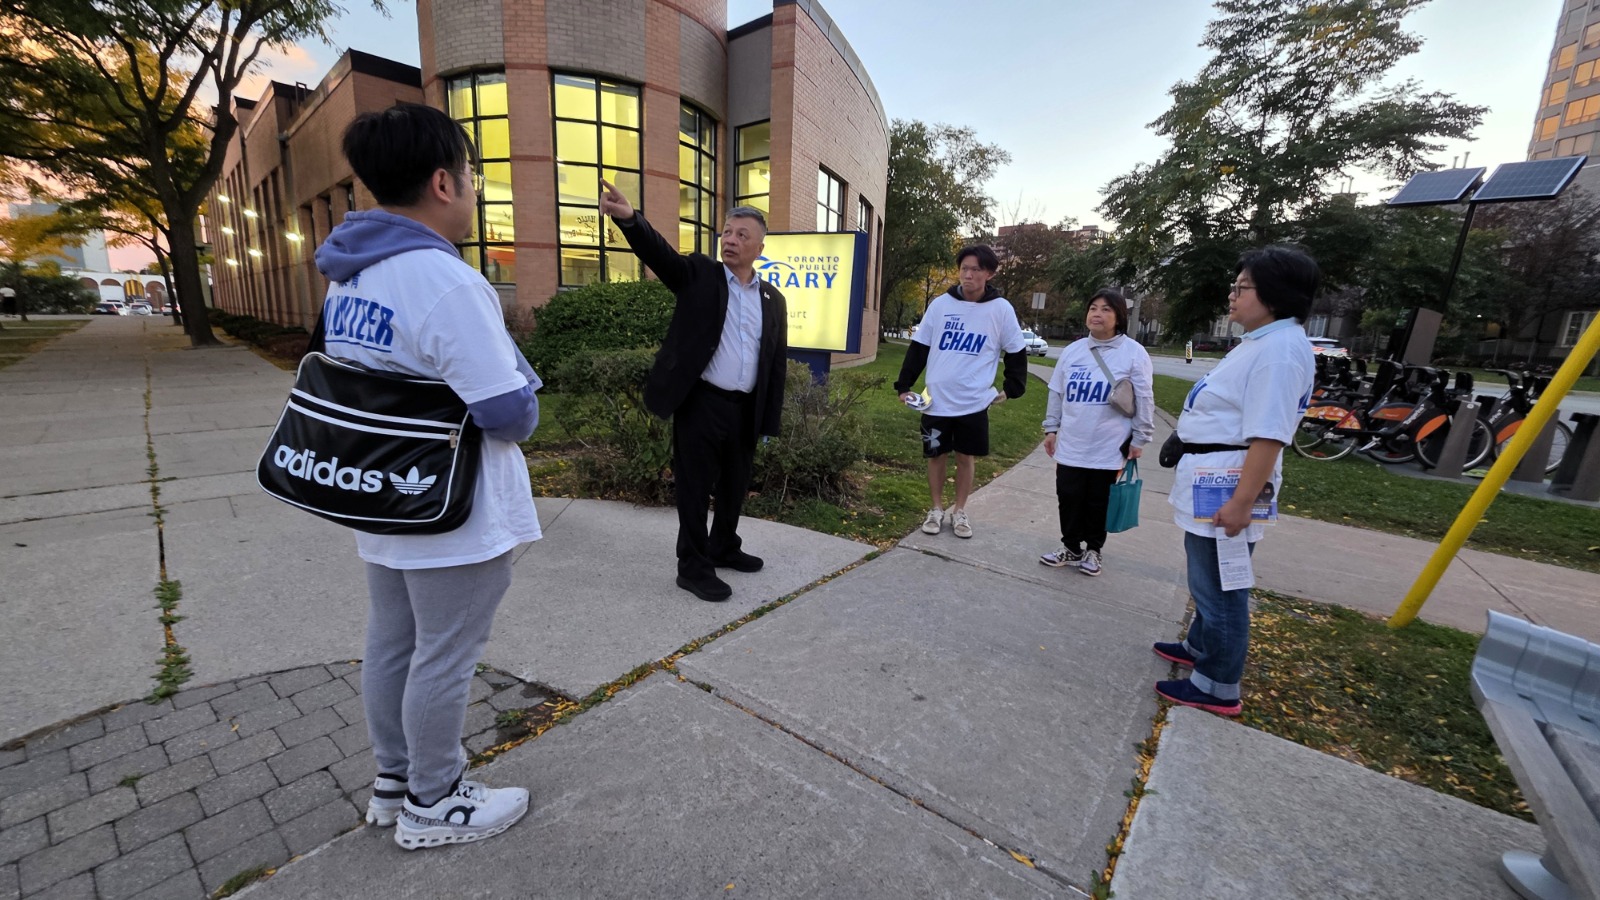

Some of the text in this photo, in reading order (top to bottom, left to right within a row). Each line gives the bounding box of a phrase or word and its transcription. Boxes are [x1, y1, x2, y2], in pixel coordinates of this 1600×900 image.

[757, 272, 837, 289] RARY
[944, 321, 965, 331] BILL
[938, 331, 987, 353] CHAN
[1069, 372, 1092, 380] BILL
[274, 444, 384, 493] adidas
[1198, 476, 1214, 484] Bill
[403, 811, 417, 822] ON
